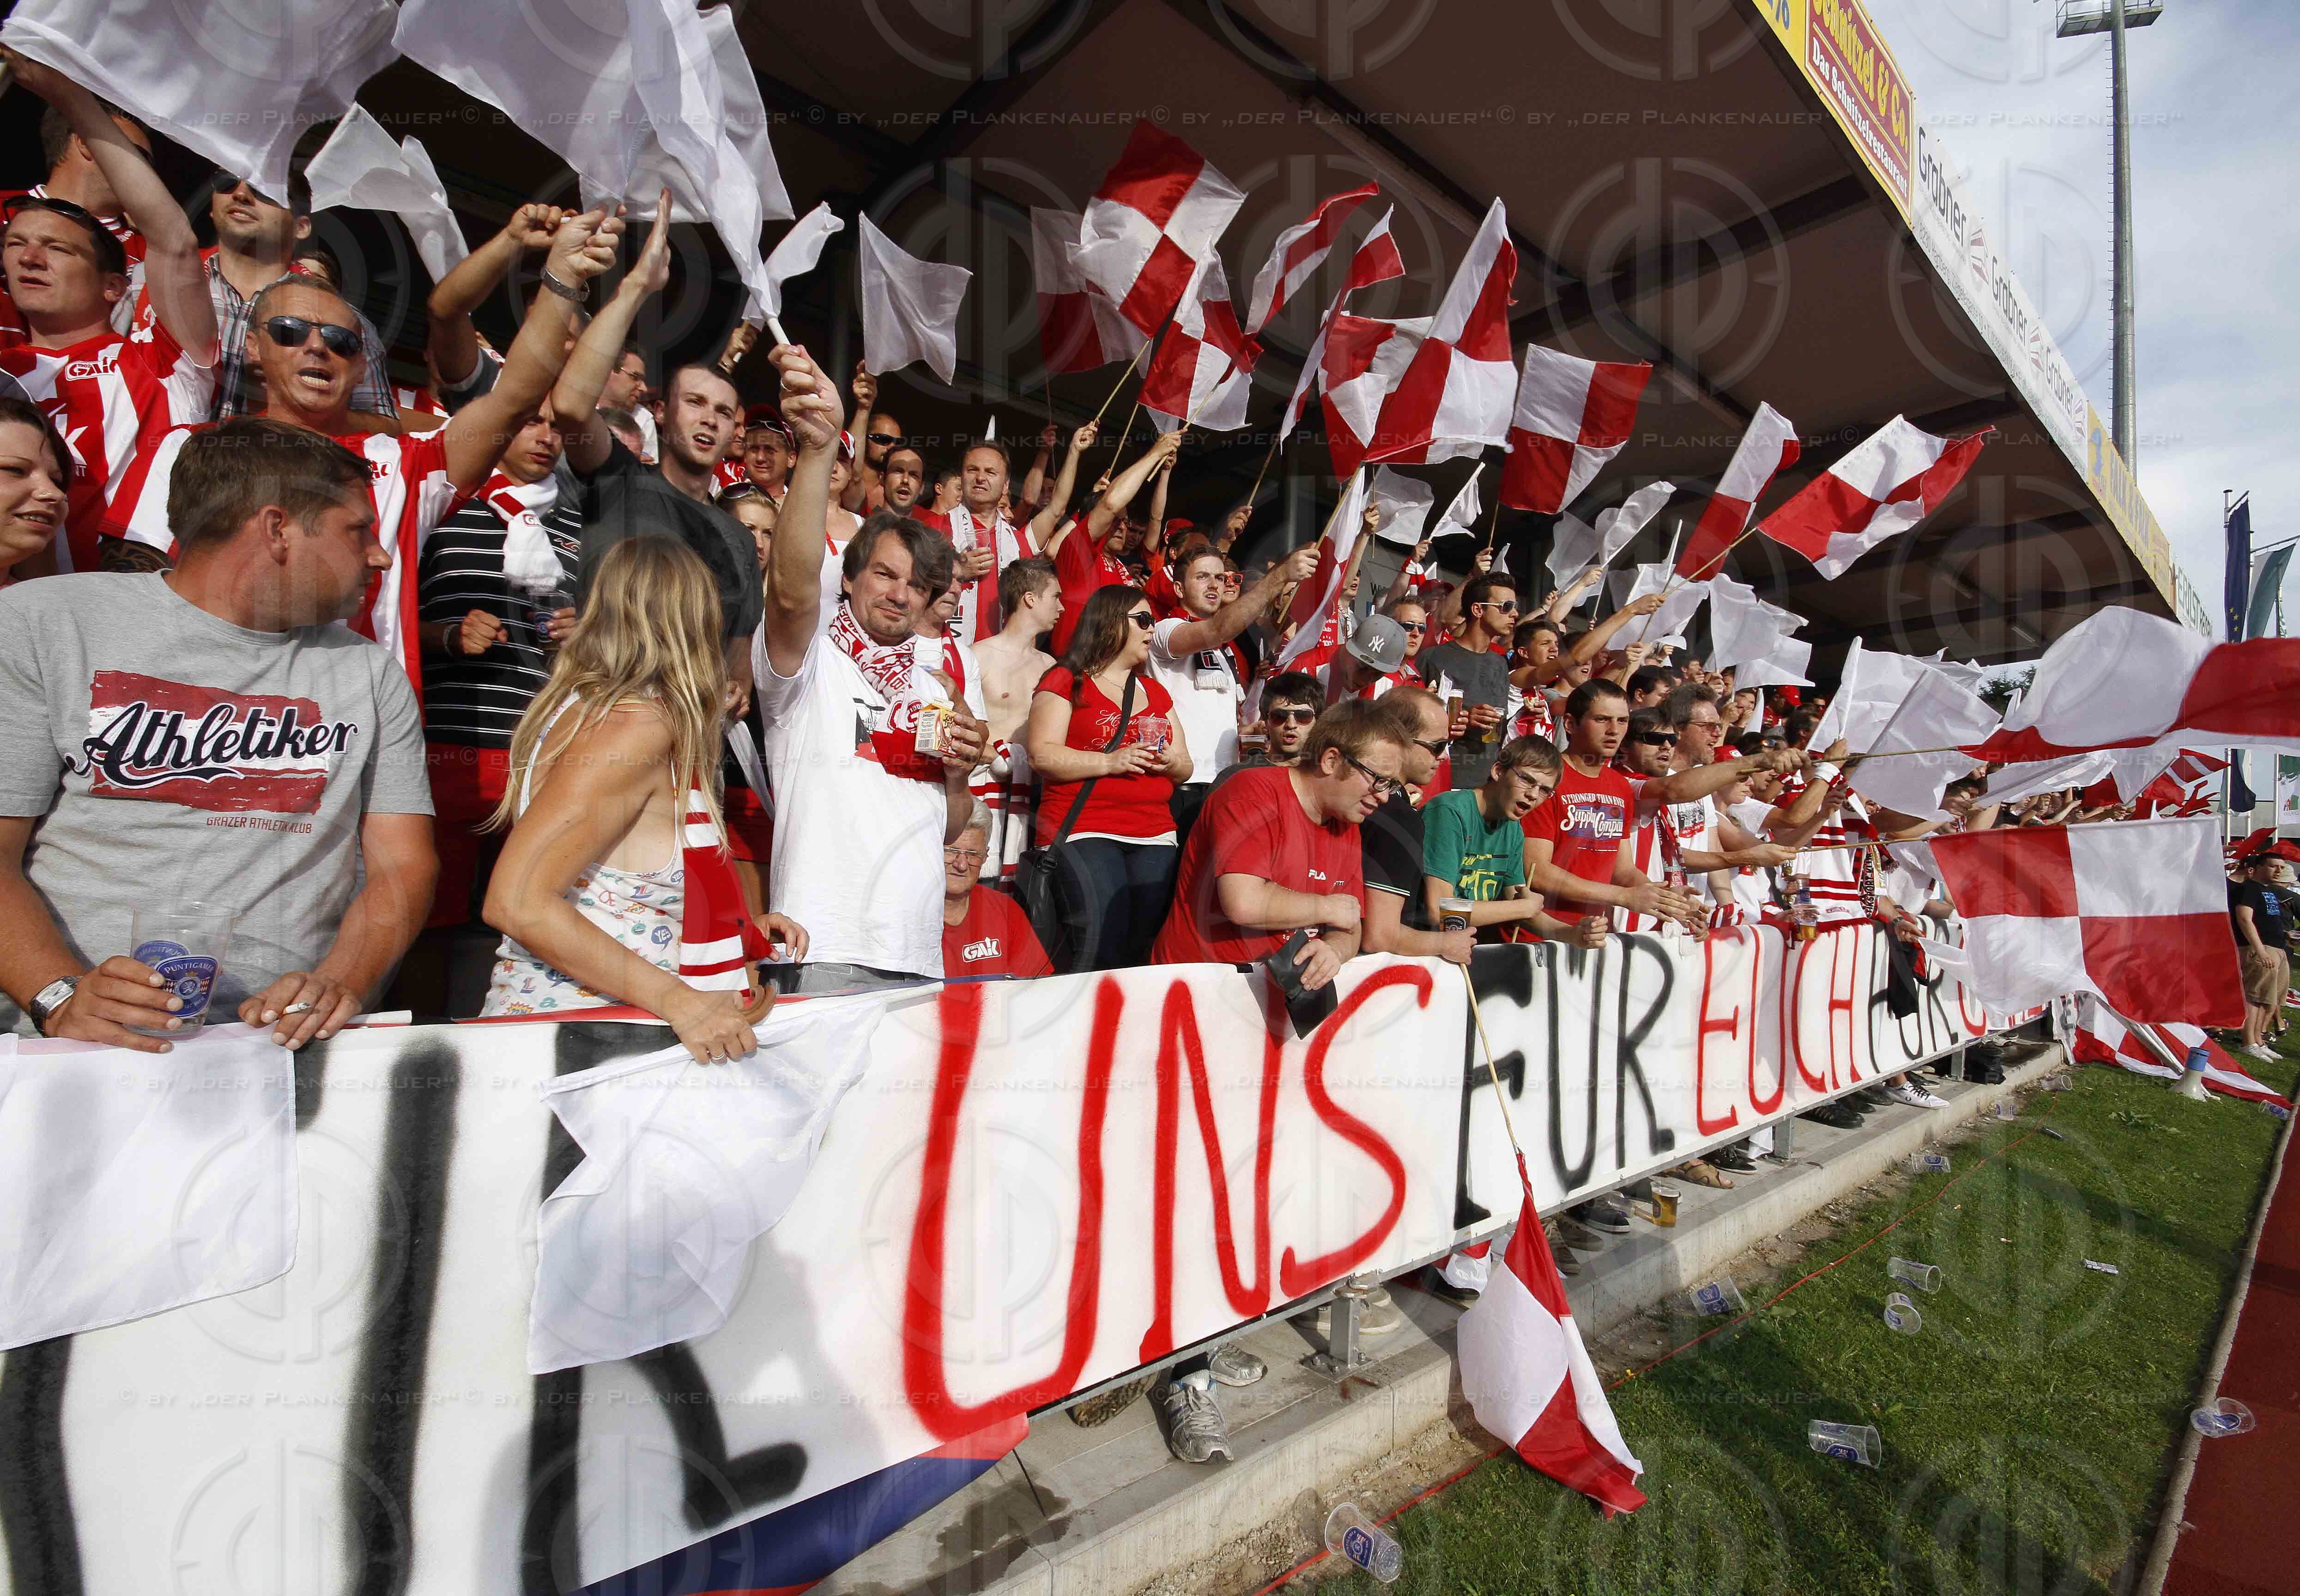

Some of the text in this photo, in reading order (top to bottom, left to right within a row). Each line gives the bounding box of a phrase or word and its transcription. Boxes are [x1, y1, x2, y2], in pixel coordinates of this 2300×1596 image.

[1812, 36, 1907, 198] Das Schnitzelrestaurant
[1813, 0, 1874, 102] chnitzel
[1891, 83, 1908, 154] Co.
[1919, 126, 1967, 248] Grabner
[1992, 255, 2028, 346] Grabner
[2046, 346, 2073, 418] Grabner
[65, 700, 360, 789] Athletiker
[206, 816, 247, 828] GRAZER
[1560, 804, 1596, 831] Supply
[1561, 793, 1625, 808] STRONGER THAN EVER
[672, 871, 684, 881] YES
[654, 929, 670, 943] YES
[903, 963, 1433, 1442] UNS
[1453, 931, 1675, 1231] FÜR
[1696, 924, 1863, 1137] EUCH
